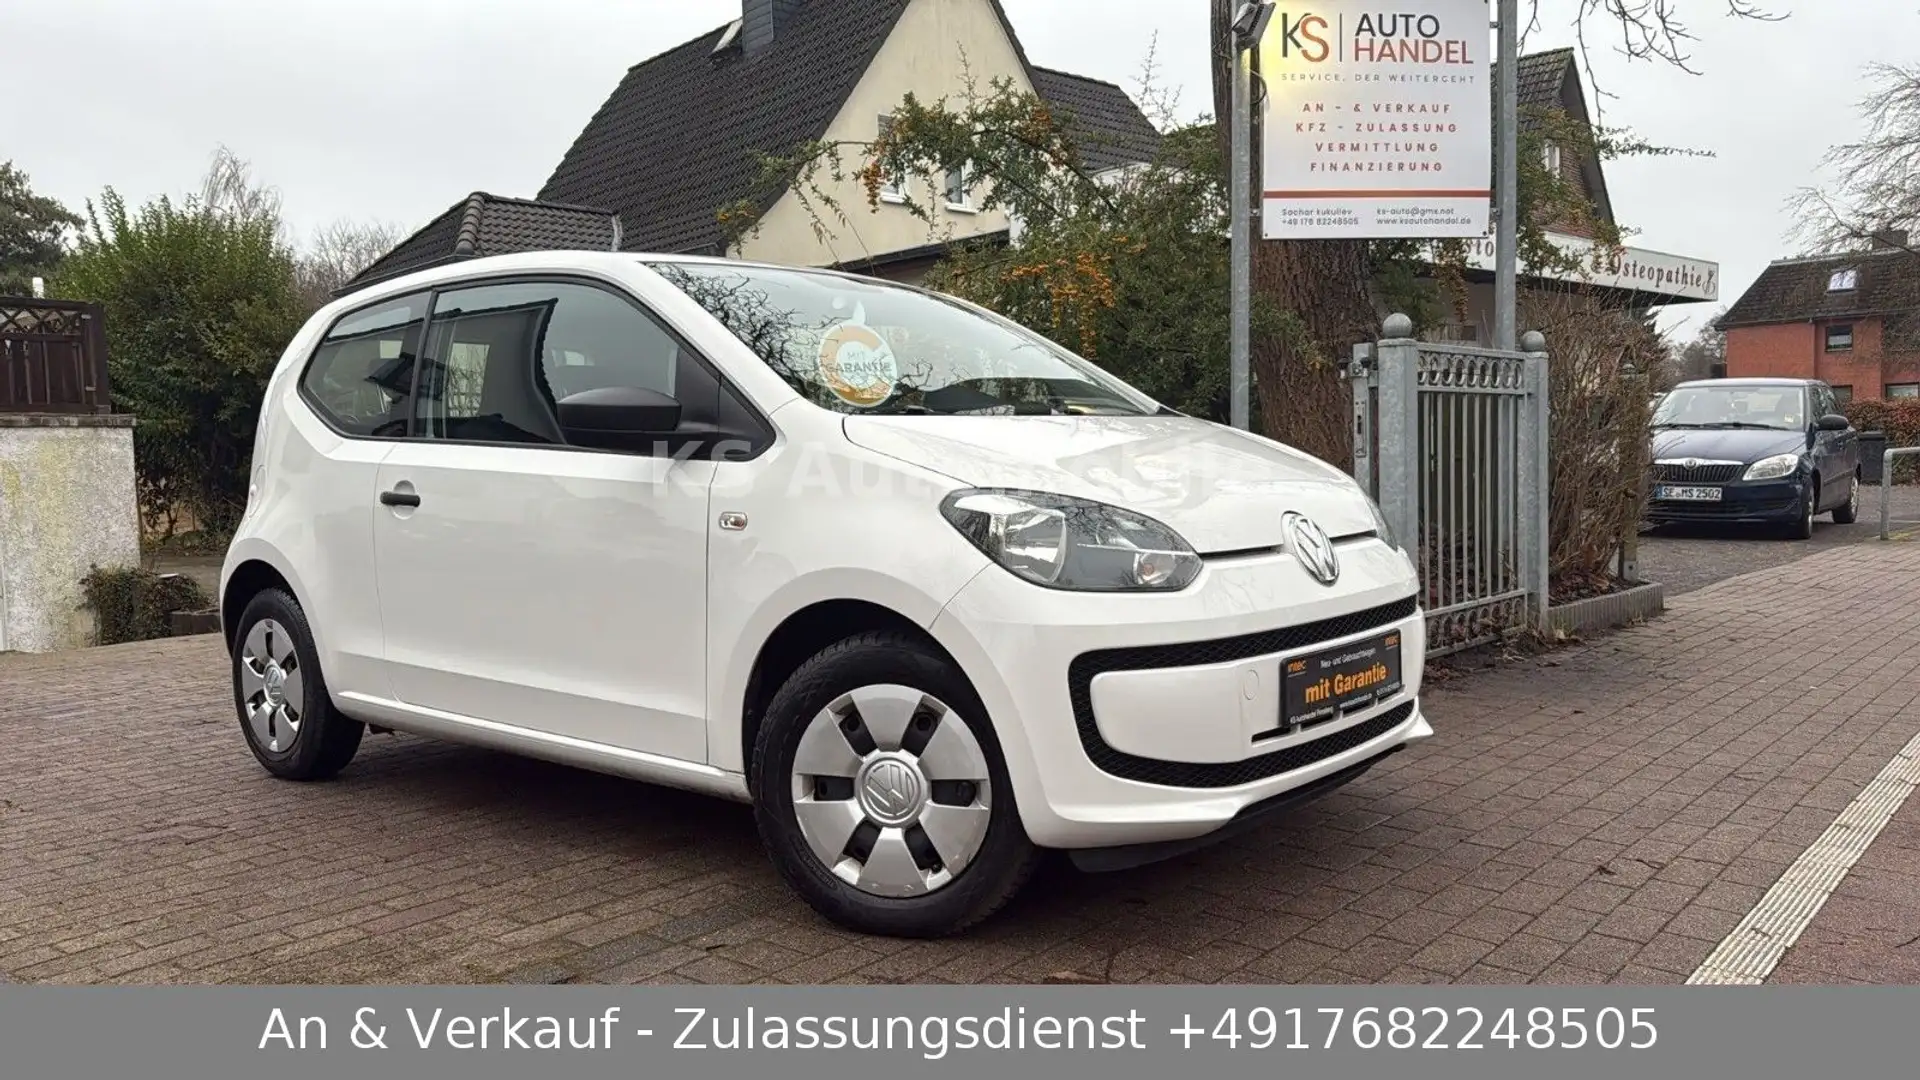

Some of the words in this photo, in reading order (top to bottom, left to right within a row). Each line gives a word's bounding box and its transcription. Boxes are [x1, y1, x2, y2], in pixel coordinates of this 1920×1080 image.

[1355, 13, 1440, 38] AUTO
[1281, 13, 1330, 63] KS
[1354, 38, 1474, 64] HANDEL
[1355, 74, 1380, 82] DER
[1389, 74, 1475, 84] WEITERGEHT
[1302, 103, 1325, 113] AN
[1353, 103, 1361, 113] &
[1373, 103, 1451, 114] VERKAUF
[1295, 123, 1327, 133] KFZ
[1355, 123, 1458, 133] ZULASSUNG
[1315, 142, 1439, 153] VERMITTLUNG
[1310, 162, 1443, 172] FINANZIERUNG
[1305, 677, 1330, 704] mit
[1334, 662, 1387, 695] Garantie
